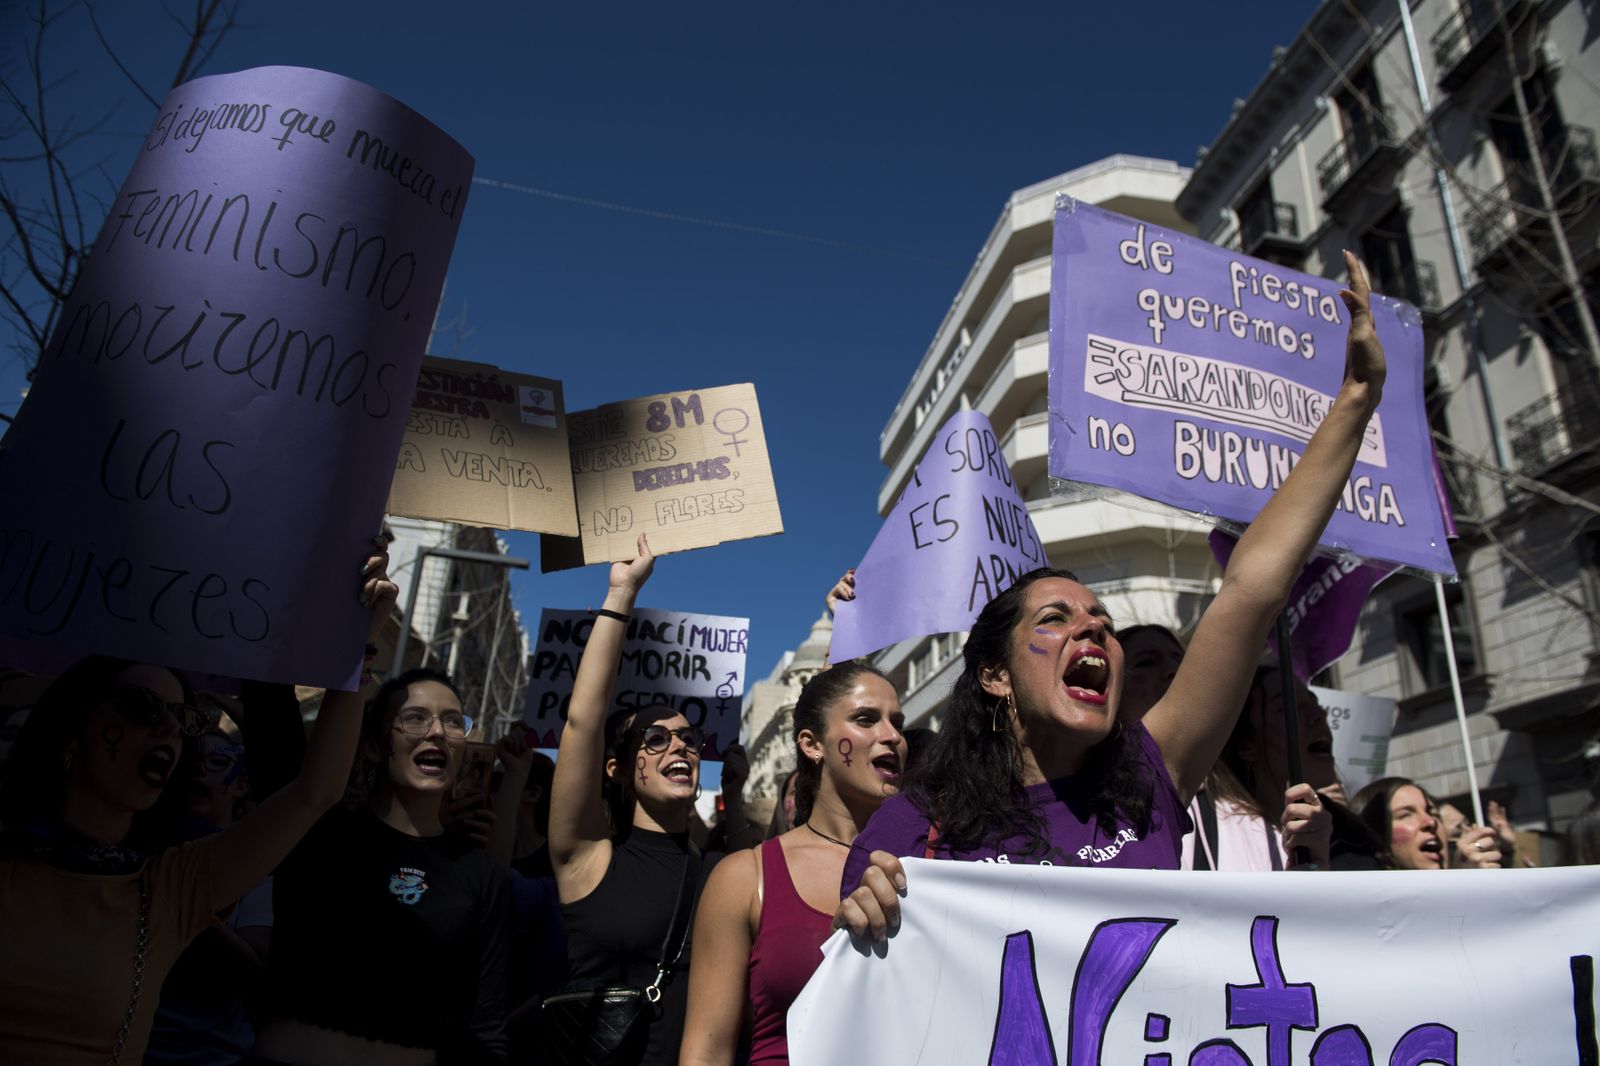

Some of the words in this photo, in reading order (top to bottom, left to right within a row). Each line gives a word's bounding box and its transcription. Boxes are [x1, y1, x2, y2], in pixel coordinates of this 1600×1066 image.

[174, 102, 272, 154] dejamos
[271, 106, 336, 151] que
[440, 184, 463, 220] el
[1119, 224, 1175, 275] de
[1137, 288, 1315, 361] queremos
[1114, 346, 1336, 429] SARANDONG
[568, 410, 628, 447] STE
[646, 393, 705, 434] 8M
[1088, 415, 1136, 456] no
[397, 442, 426, 473] A
[441, 448, 553, 493] VENTA.
[571, 433, 677, 474] UEREMOS
[593, 505, 634, 537] NO
[655, 488, 745, 527] FLORES
[909, 493, 960, 550] ES
[982, 494, 1048, 568] NUES
[543, 618, 595, 647] NO
[689, 623, 749, 654] MUJER
[616, 647, 712, 682] MORIR
